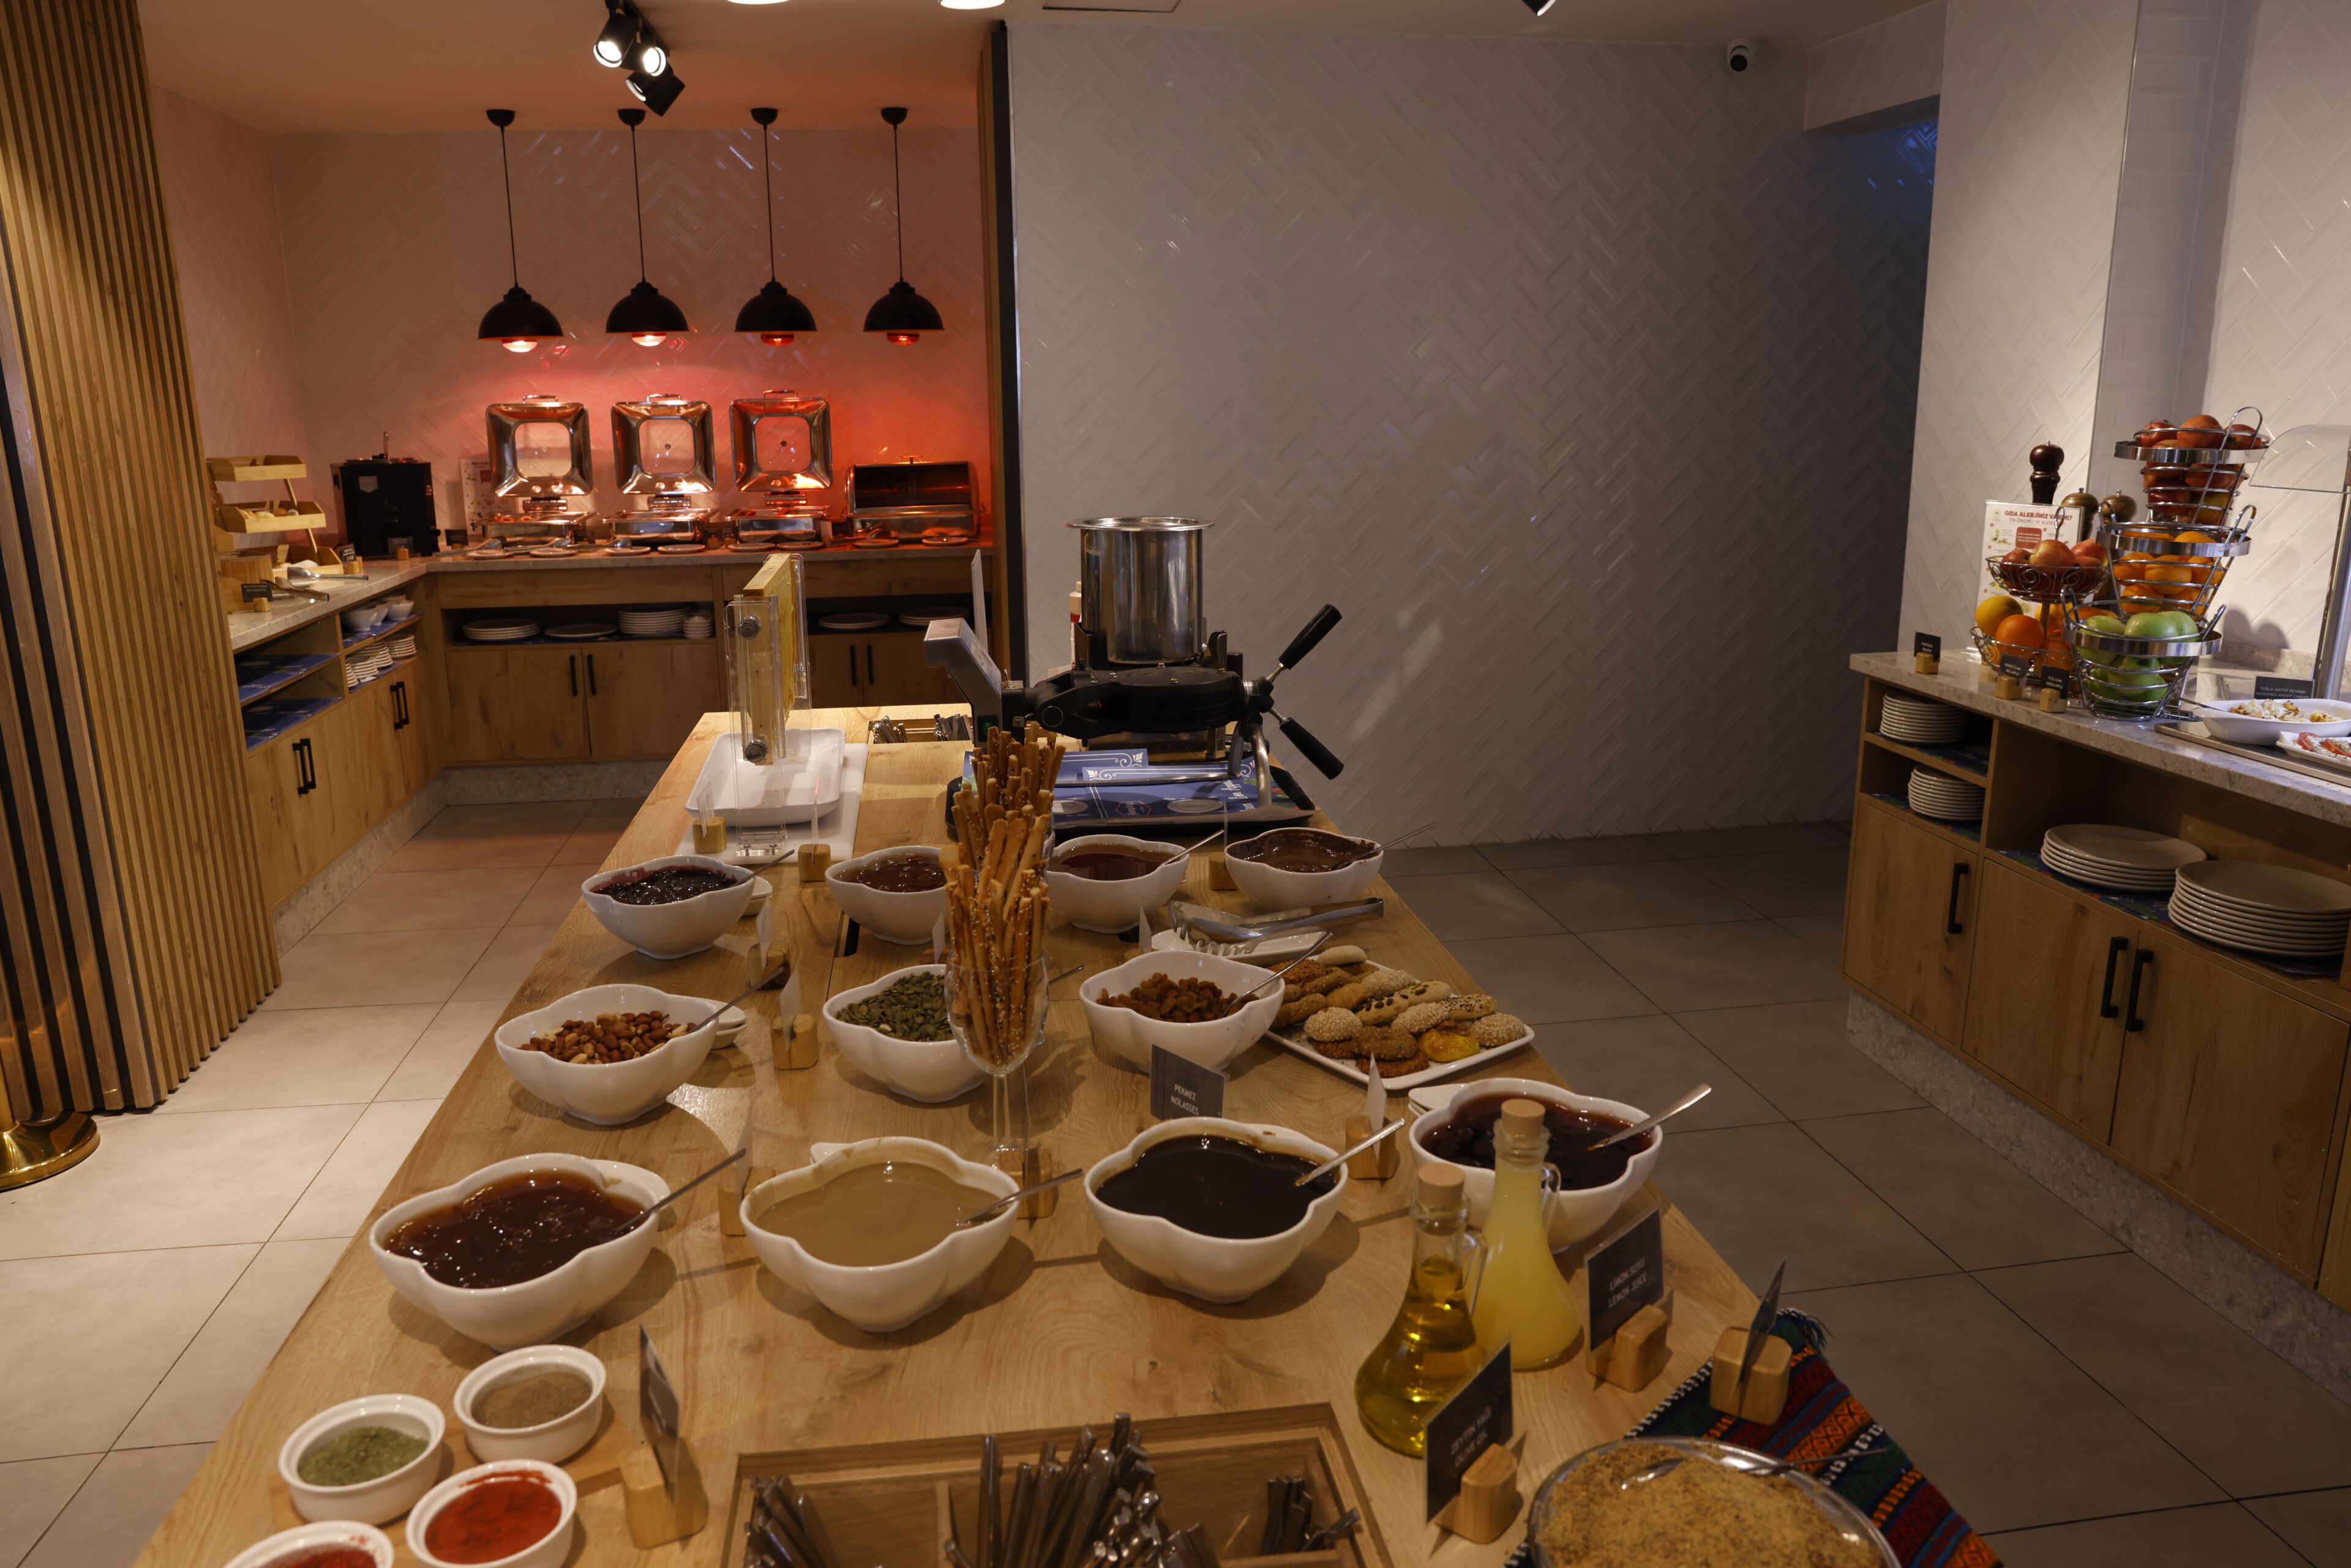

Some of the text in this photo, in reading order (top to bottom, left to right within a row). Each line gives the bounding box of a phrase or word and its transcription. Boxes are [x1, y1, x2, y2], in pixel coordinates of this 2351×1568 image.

[1174, 1084, 1196, 1101] PEKMEZ
[1171, 1095, 1199, 1115] MOLASSES
[1630, 1257, 1645, 1277] SUYU
[1609, 1272, 1646, 1308] LEMON JUICE
